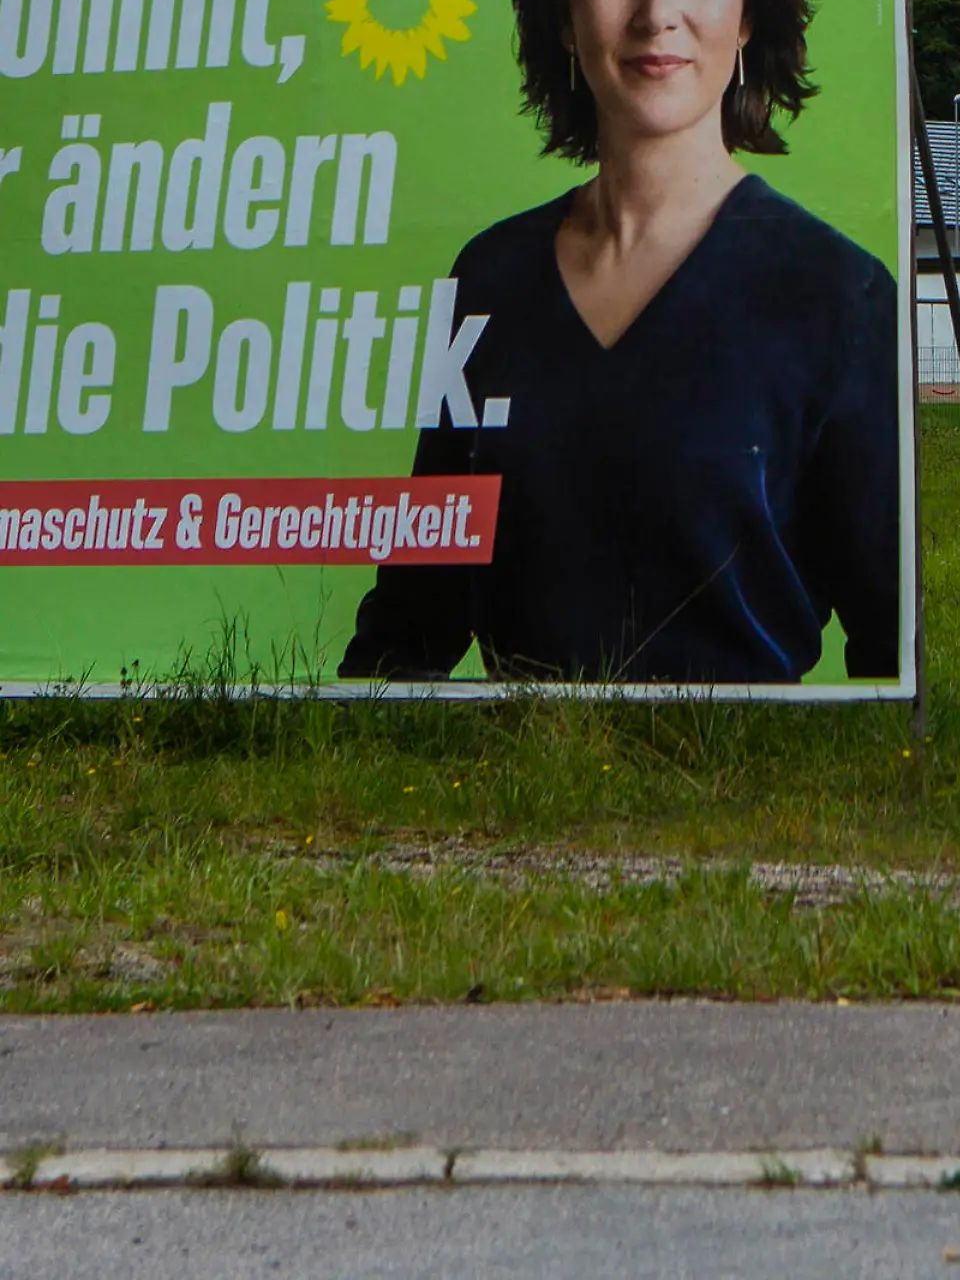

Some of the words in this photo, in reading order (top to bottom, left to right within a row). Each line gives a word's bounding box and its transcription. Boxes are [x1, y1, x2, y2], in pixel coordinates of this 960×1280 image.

[41, 101, 398, 255] ändern
[142, 277, 511, 433] Politik.
[175, 493, 203, 550] &
[214, 492, 481, 560] Gerechtigkeit.
